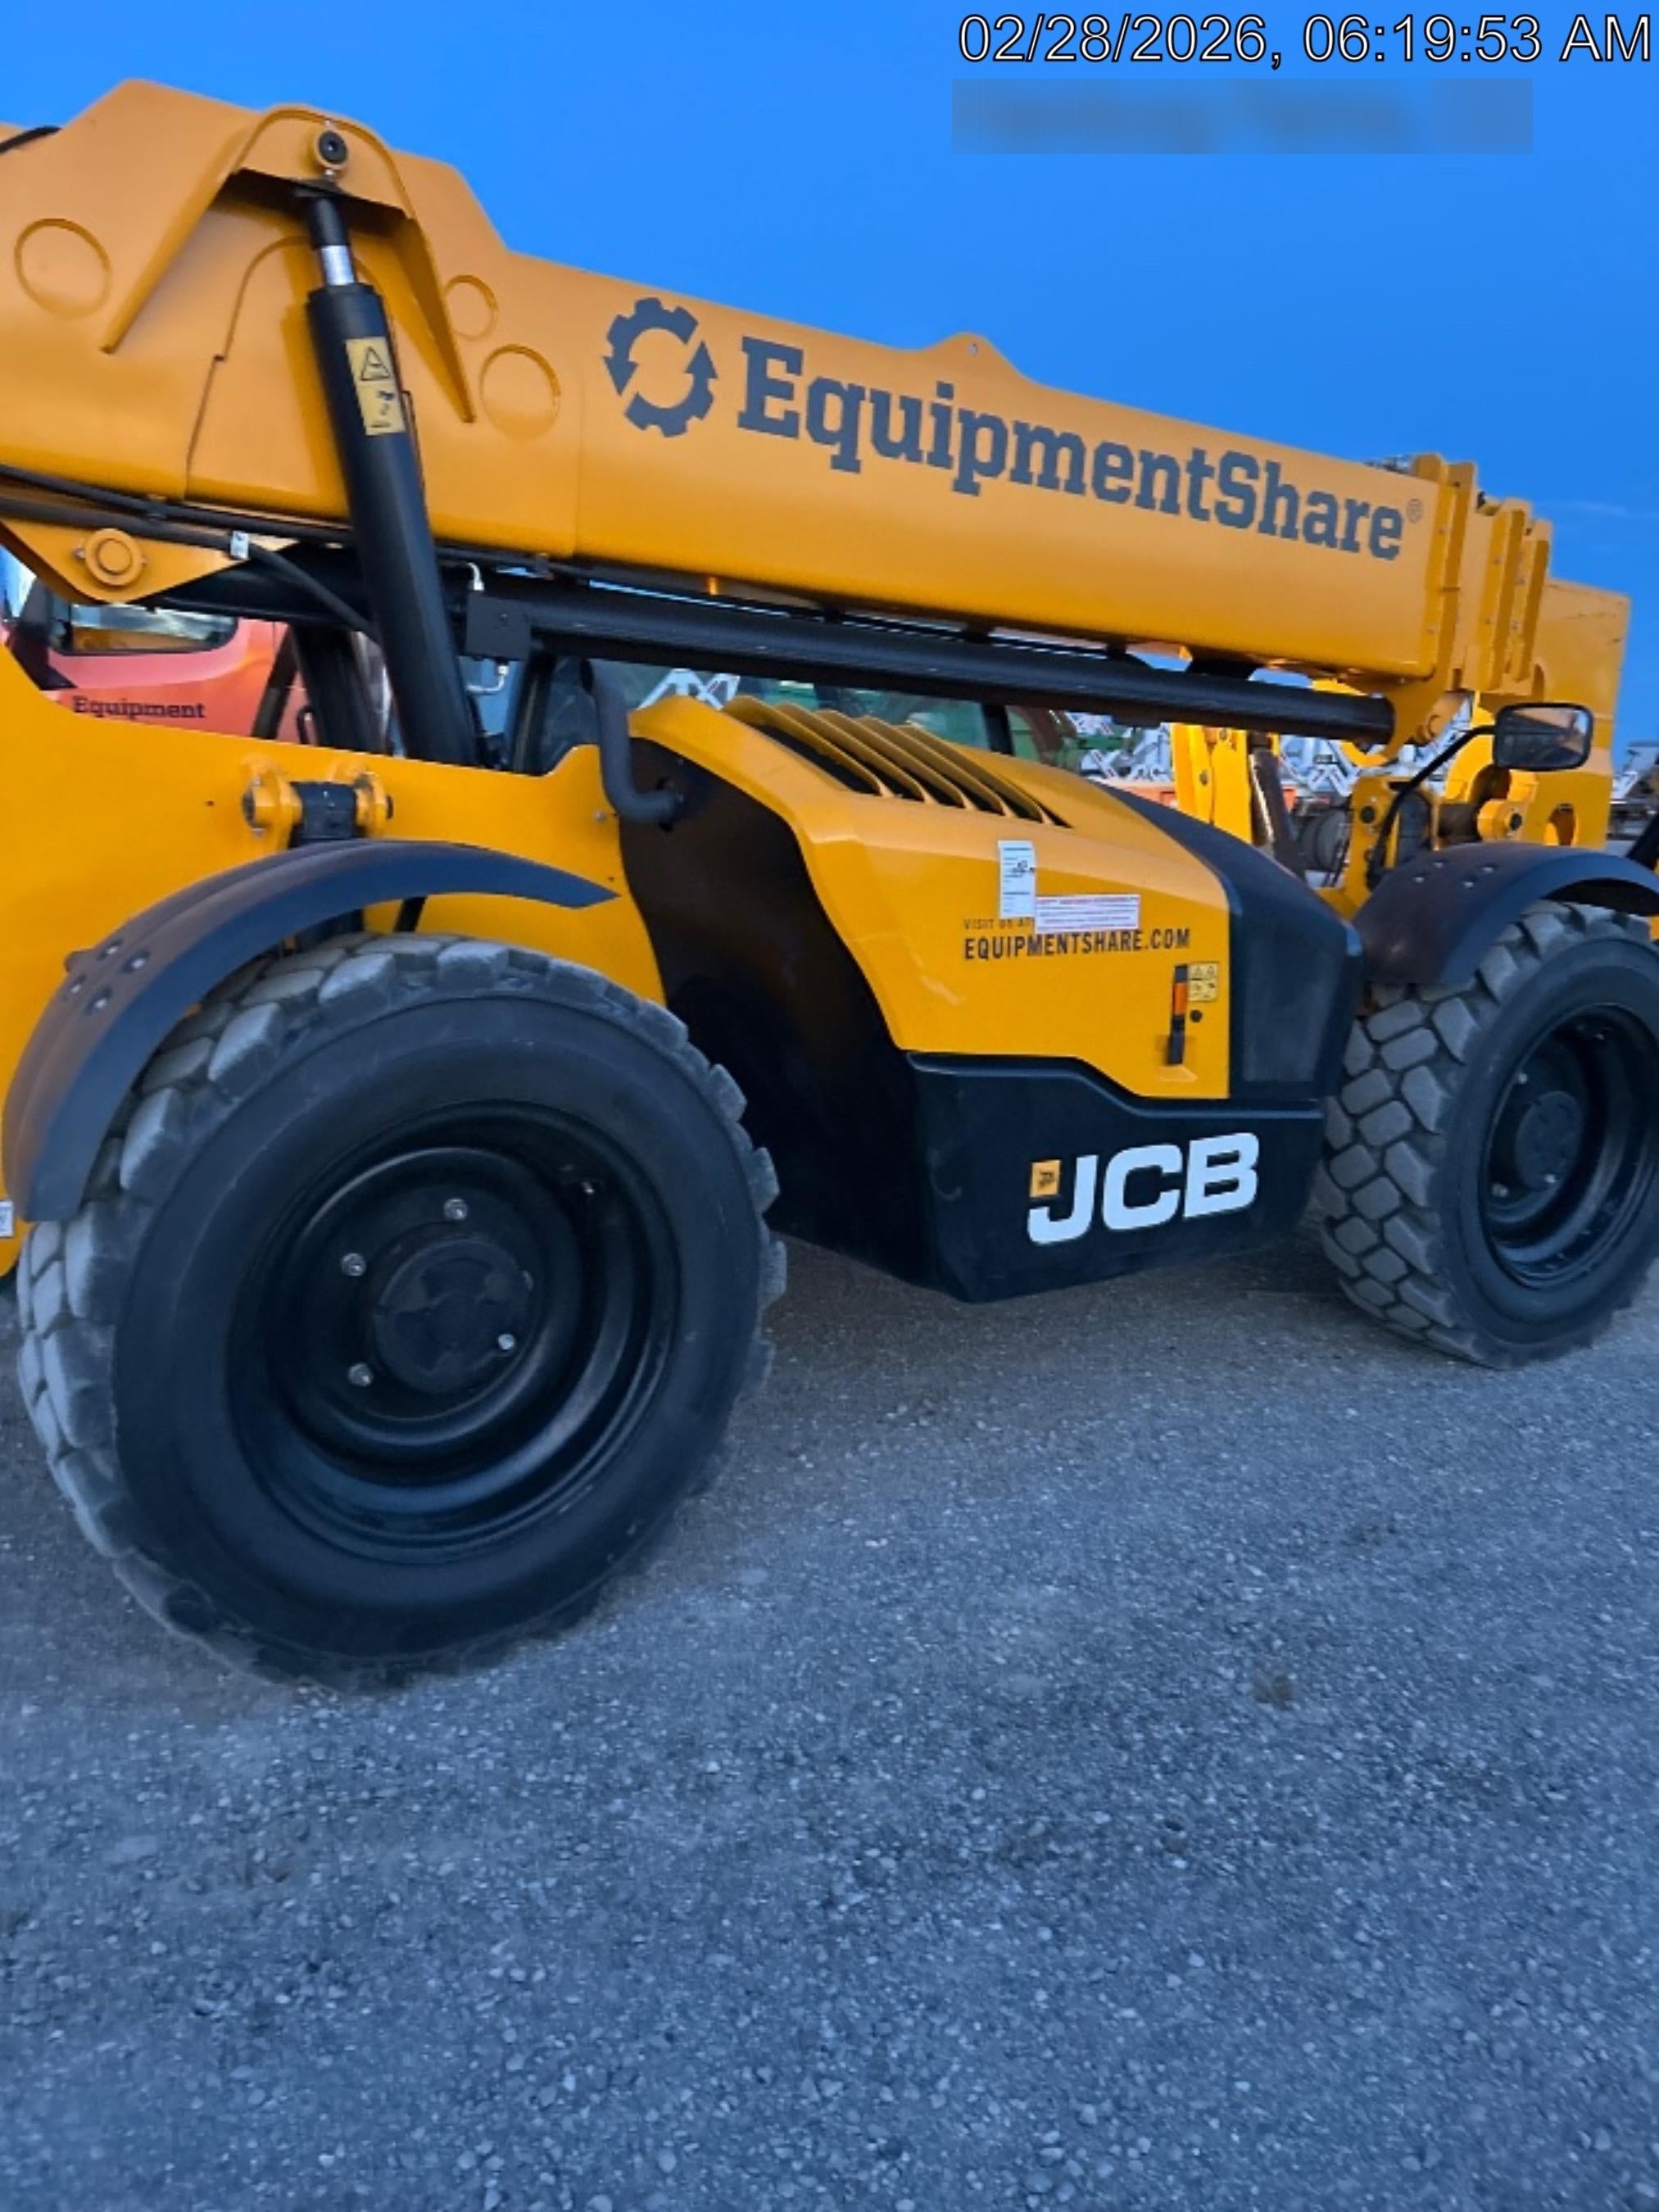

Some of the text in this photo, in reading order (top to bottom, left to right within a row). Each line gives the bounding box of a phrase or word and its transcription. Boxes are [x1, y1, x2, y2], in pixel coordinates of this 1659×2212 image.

[738, 336, 1403, 561] EquipmentShare
[73, 696, 205, 719] Equipment
[964, 929, 1190, 960] EQUIPMENTSHARE.COM
[1027, 1131, 1259, 1244] JCB
